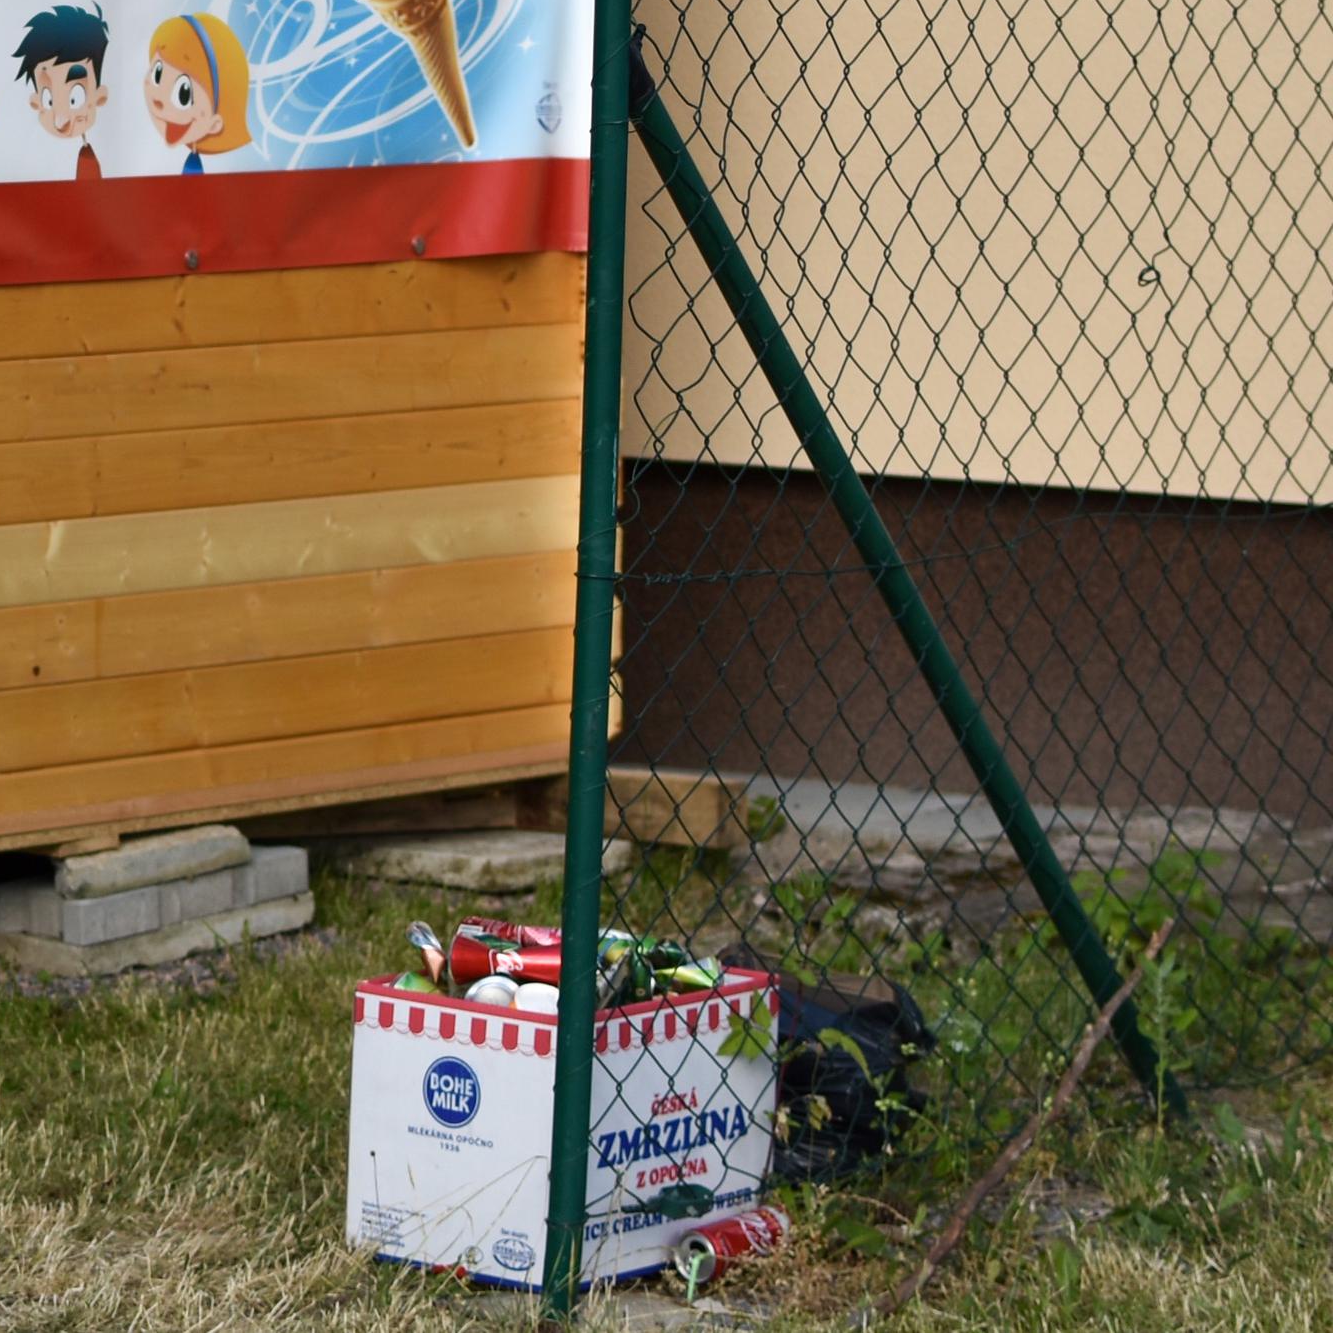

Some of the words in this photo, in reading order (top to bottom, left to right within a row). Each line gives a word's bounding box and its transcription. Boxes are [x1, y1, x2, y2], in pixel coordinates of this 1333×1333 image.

[429, 1072, 474, 1097] BOHE
[432, 1090, 470, 1114] MILK
[651, 1087, 698, 1116] ČESKÁ
[597, 1103, 749, 1169] ZMRZLINA
[636, 1171, 646, 1189] Z
[585, 1221, 609, 1241] ICE
[613, 1213, 663, 1235] CREAM
